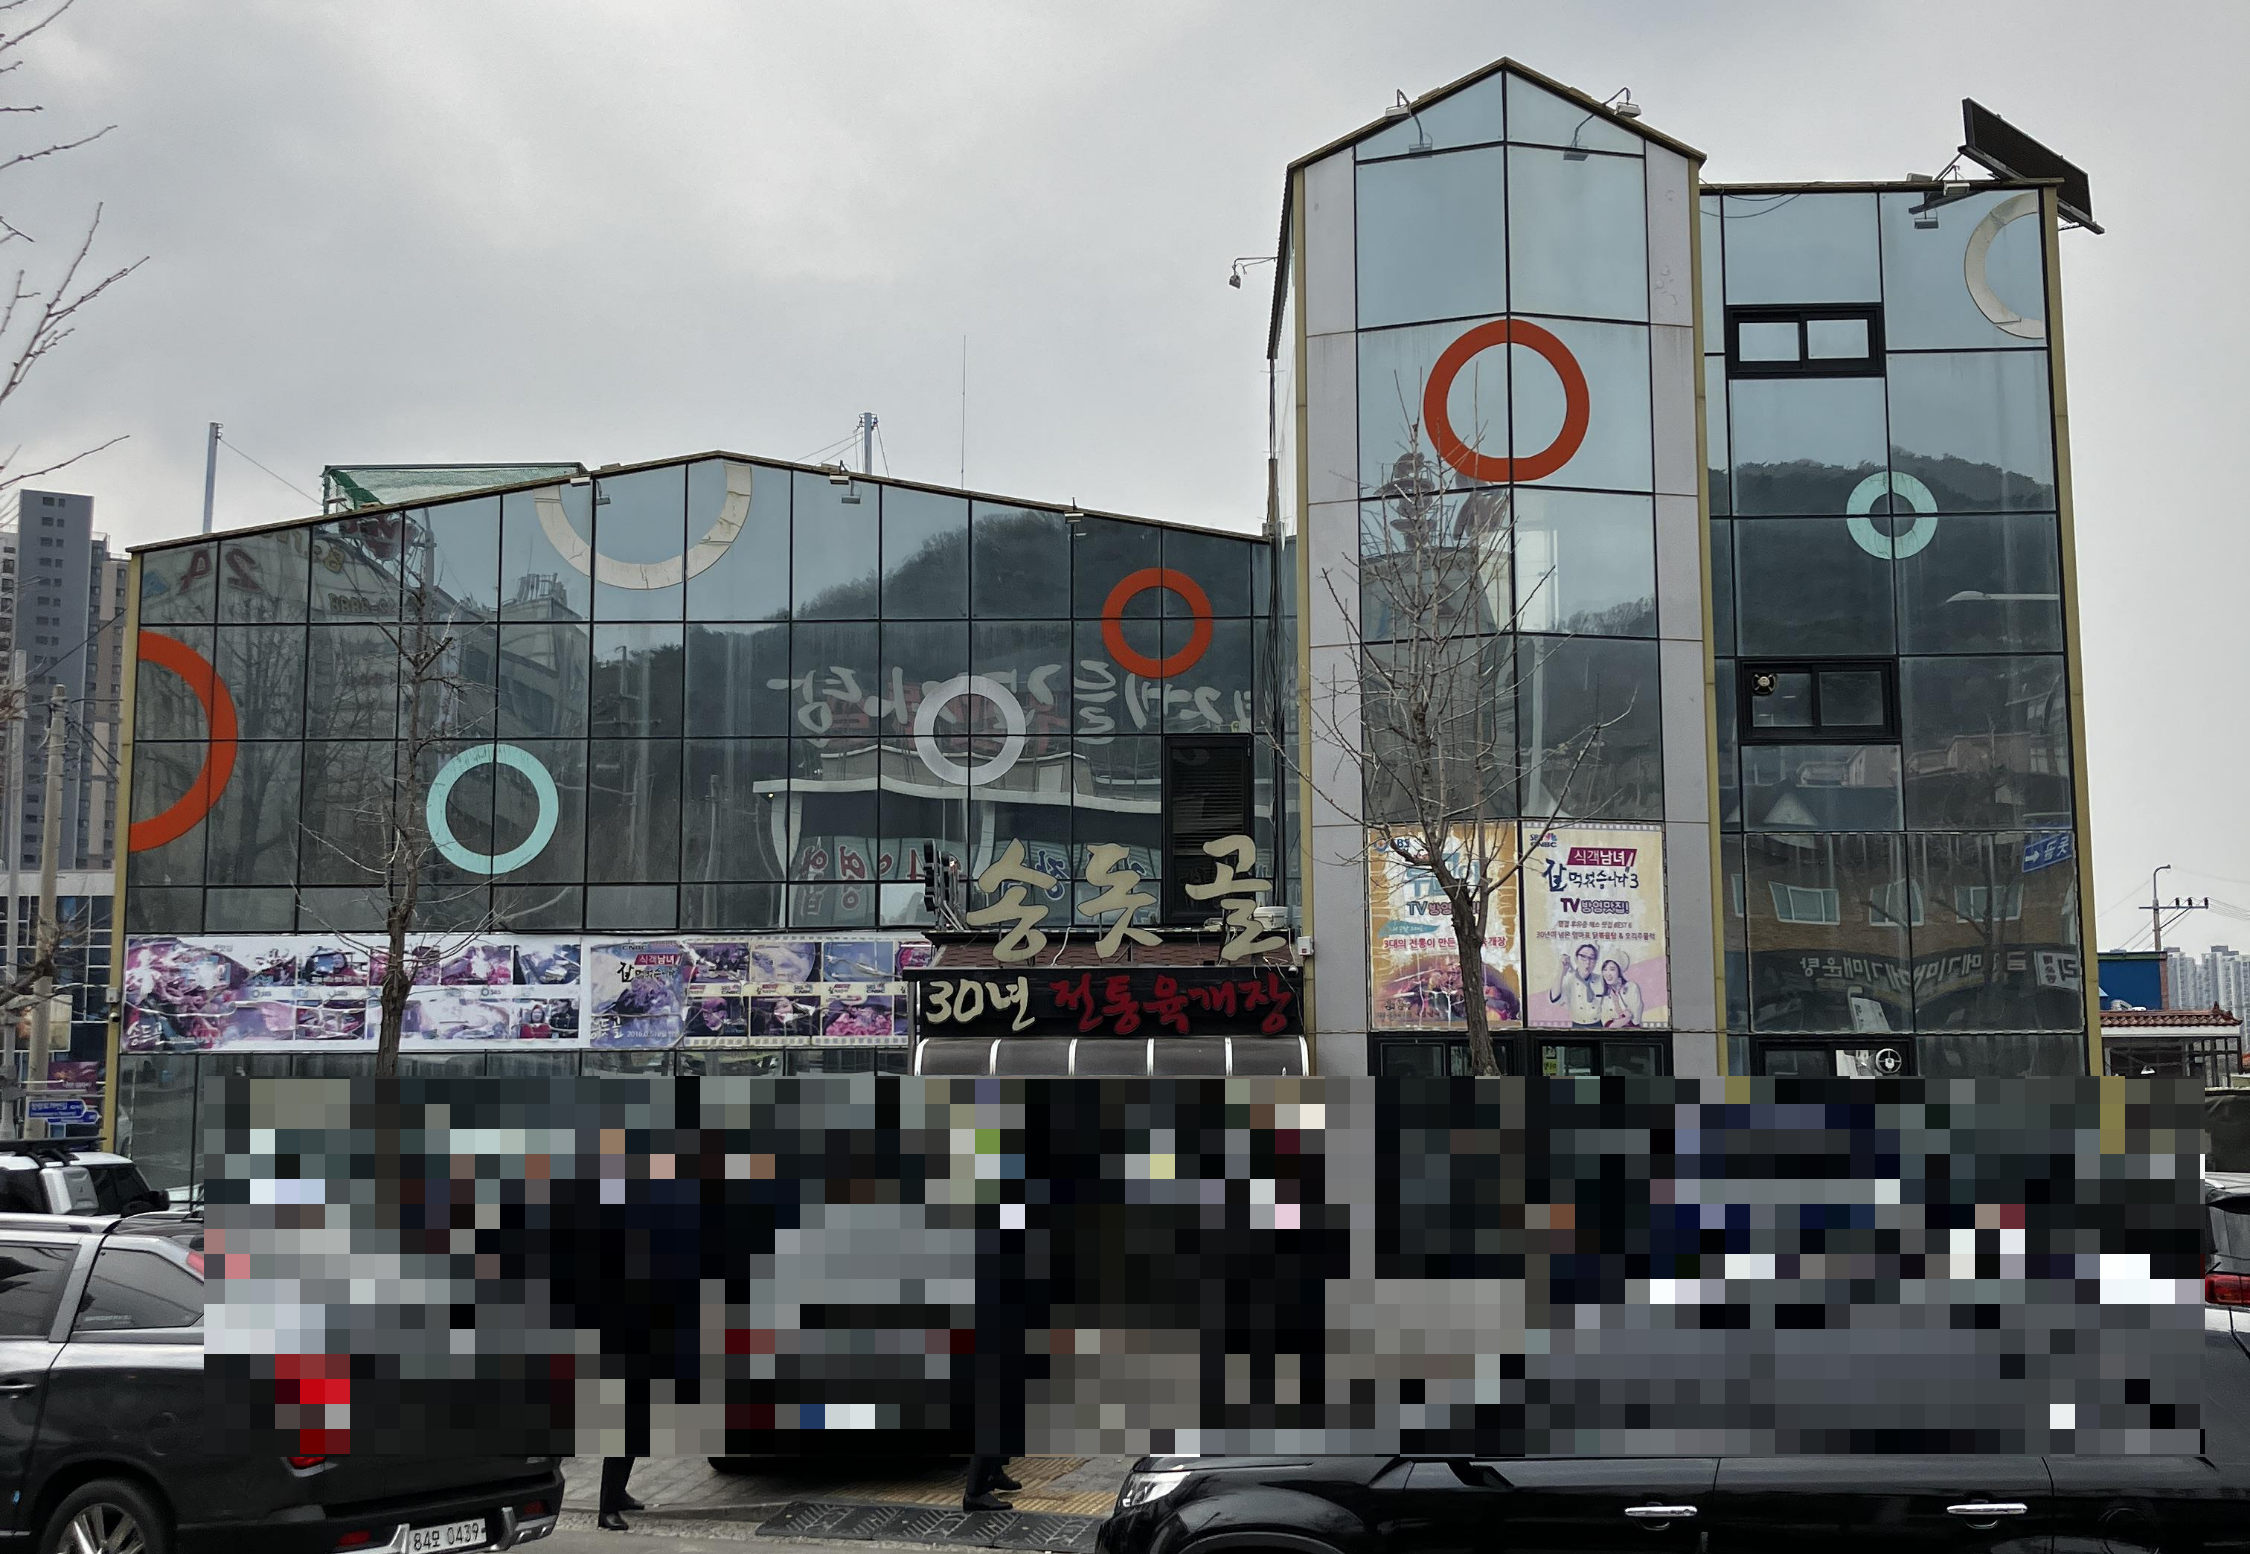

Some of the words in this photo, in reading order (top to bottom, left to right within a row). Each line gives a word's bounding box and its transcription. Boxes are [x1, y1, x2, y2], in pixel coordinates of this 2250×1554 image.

[1573, 849, 1626, 866] 식객남녀
[1542, 858, 1567, 892] 잘
[1568, 870, 1629, 890] 먹었습니다
[1629, 873, 1639, 889] 3
[1407, 900, 1427, 915] TV
[1560, 898, 1580, 912] TV
[1581, 899, 1630, 914] 방영맛집!
[1383, 939, 1406, 948] 3대의
[1409, 938, 1436, 949] 전통이
[1438, 938, 1456, 948] 만든
[639, 955, 675, 965] 식객남녀
[926, 976, 1035, 1033] 30년
[447, 1523, 479, 1545] 0439
